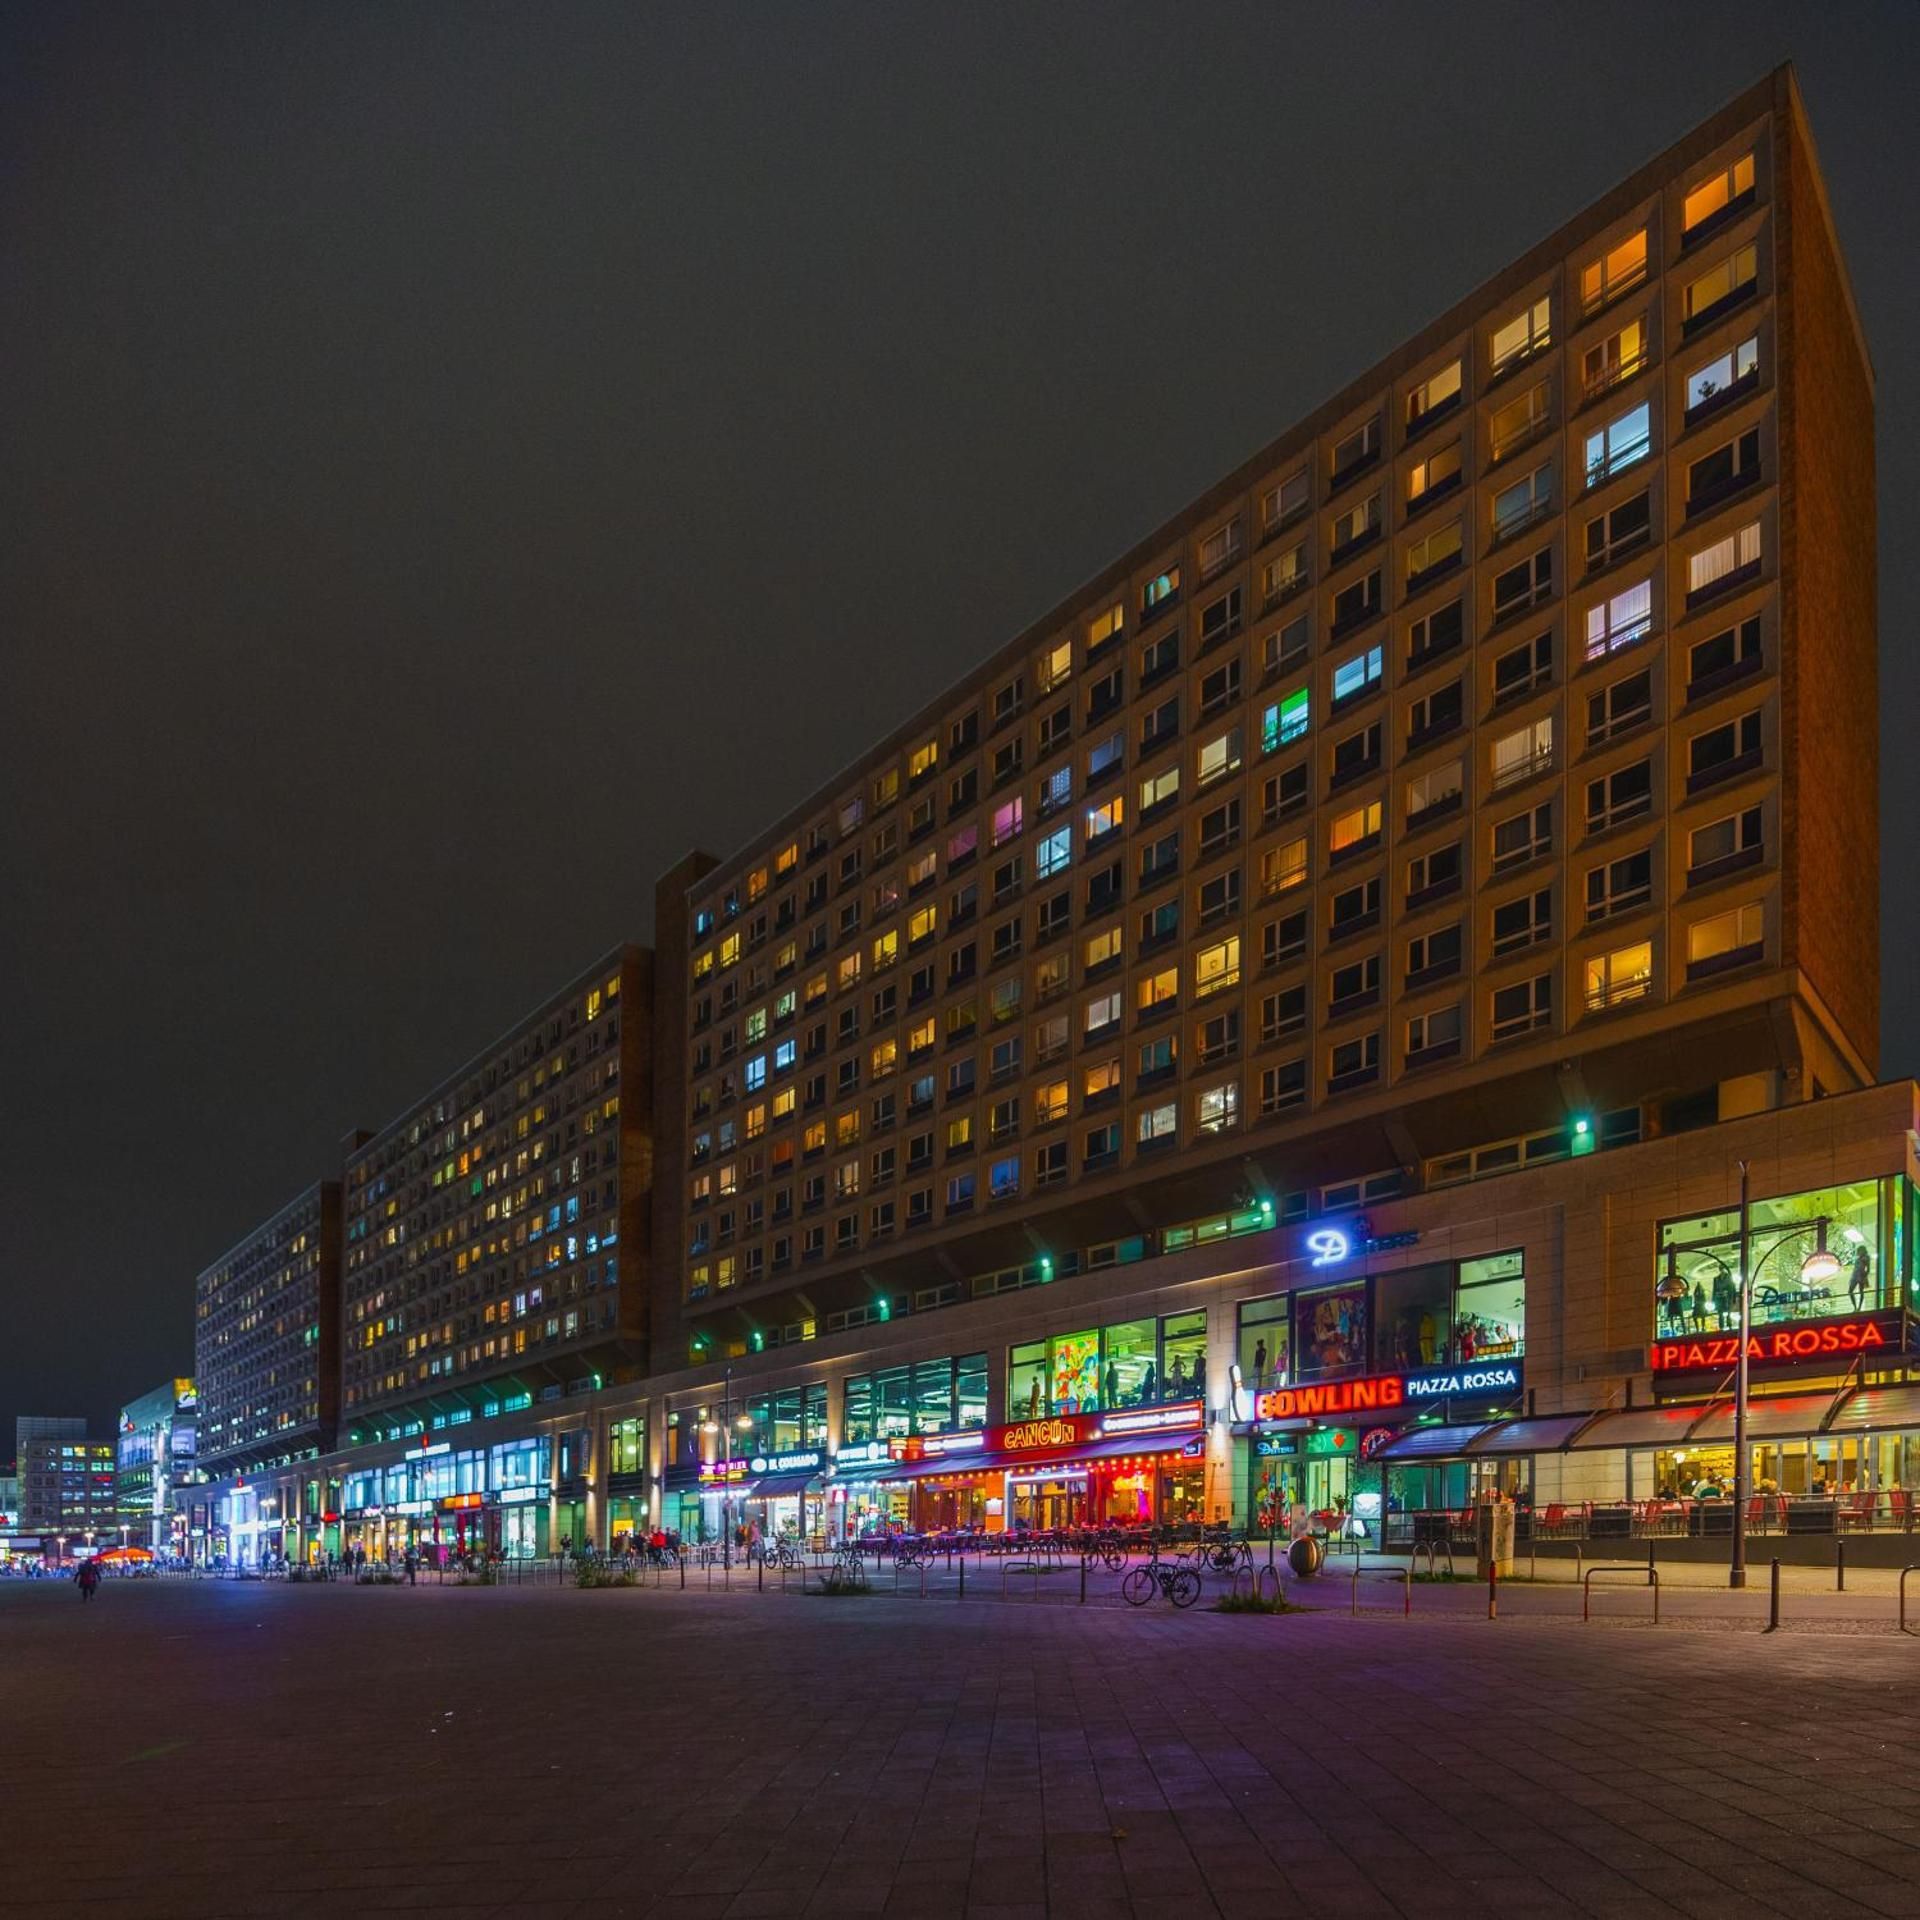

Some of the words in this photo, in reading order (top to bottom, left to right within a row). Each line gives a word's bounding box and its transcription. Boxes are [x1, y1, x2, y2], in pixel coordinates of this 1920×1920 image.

[1663, 1337, 1763, 1369] PIAZZA
[1774, 1323, 1883, 1356] ROSSA
[1258, 1379, 1402, 1419] BOWLING
[1408, 1377, 1459, 1396] PIAZZA
[1464, 1370, 1516, 1390] ROSSA
